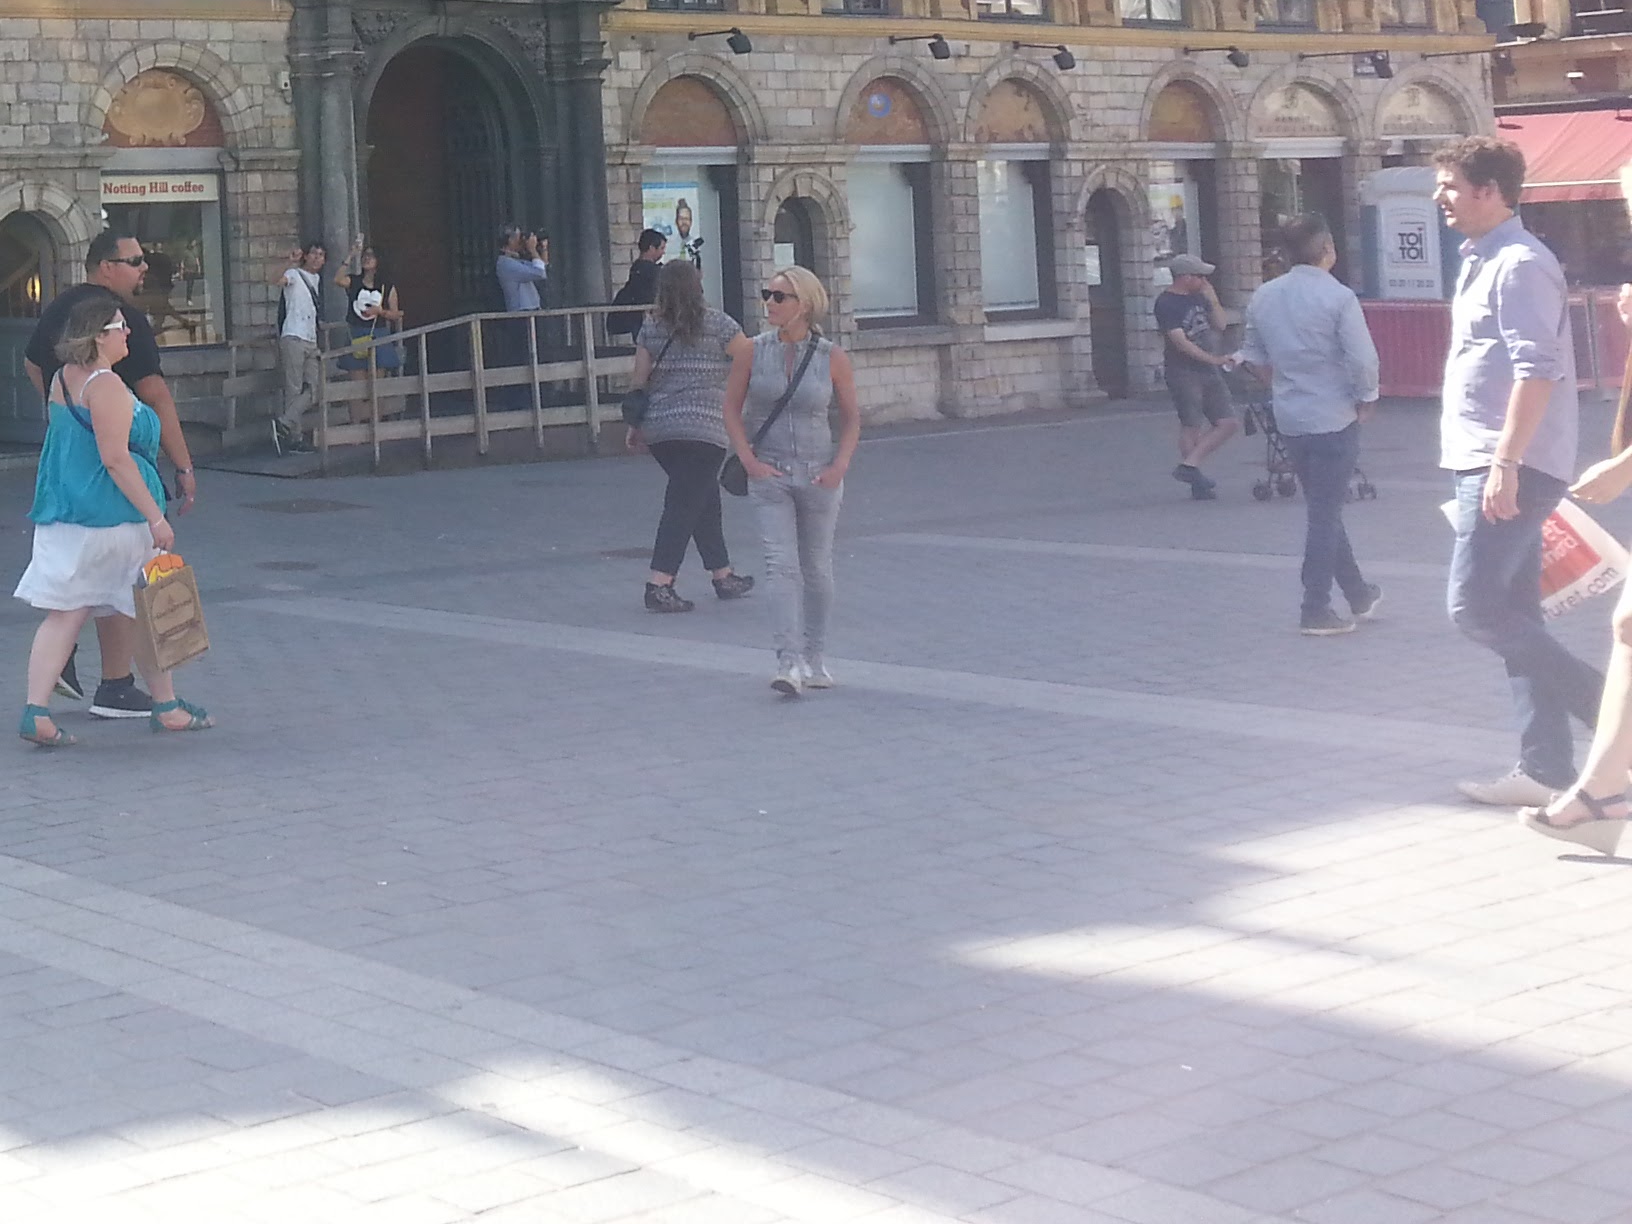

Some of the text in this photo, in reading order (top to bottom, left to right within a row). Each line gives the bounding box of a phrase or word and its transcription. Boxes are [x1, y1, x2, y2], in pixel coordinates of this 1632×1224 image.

[103, 181, 205, 196] Notting Hill coffee
[1398, 246, 1424, 260] TOI
